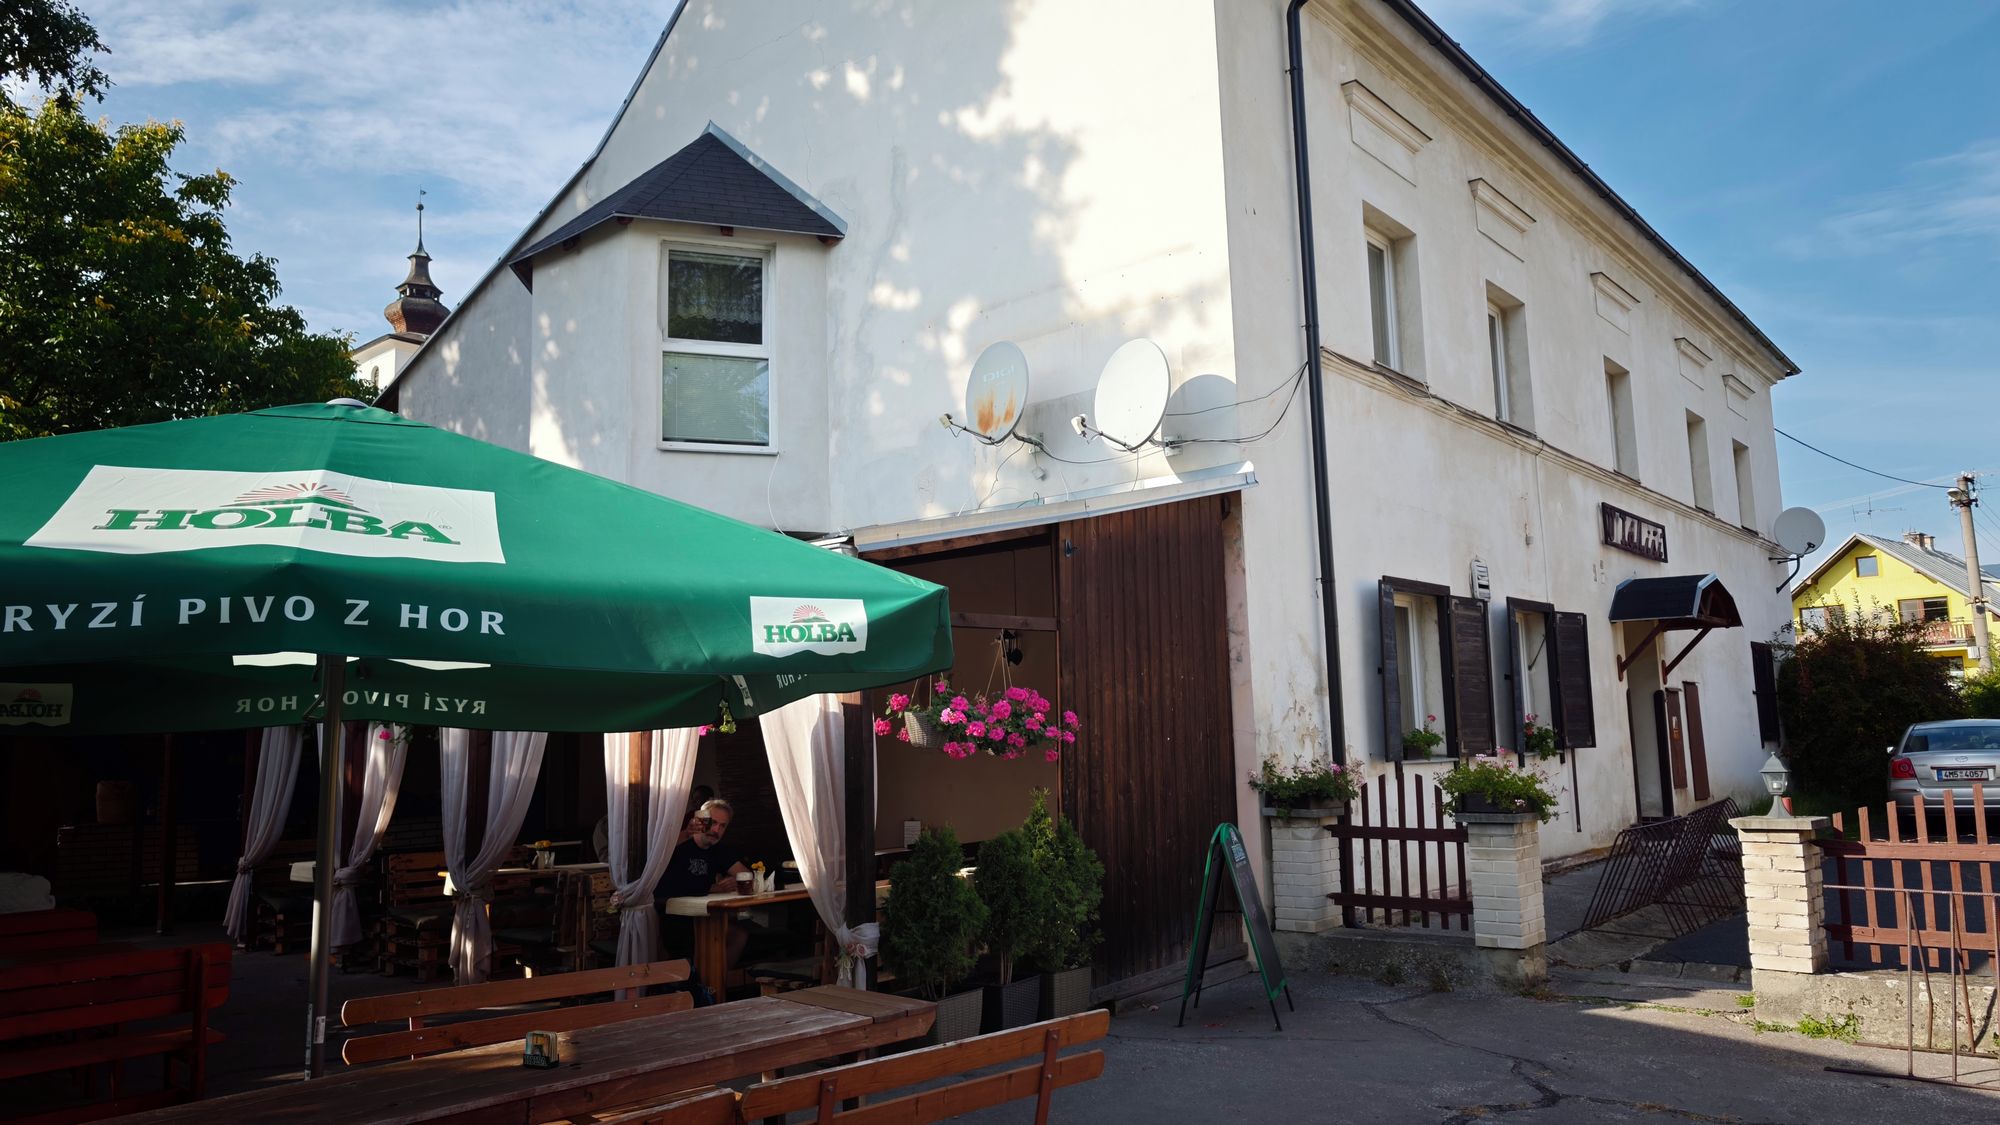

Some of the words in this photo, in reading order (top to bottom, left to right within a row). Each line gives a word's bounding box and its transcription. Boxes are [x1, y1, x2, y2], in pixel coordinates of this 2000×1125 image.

[93, 505, 460, 545] HOLBA
[3, 593, 147, 633] RYZÍ
[179, 596, 315, 625] PIVO
[344, 600, 370, 626] Z
[399, 603, 506, 635] HOR
[763, 622, 857, 643] HOLBA
